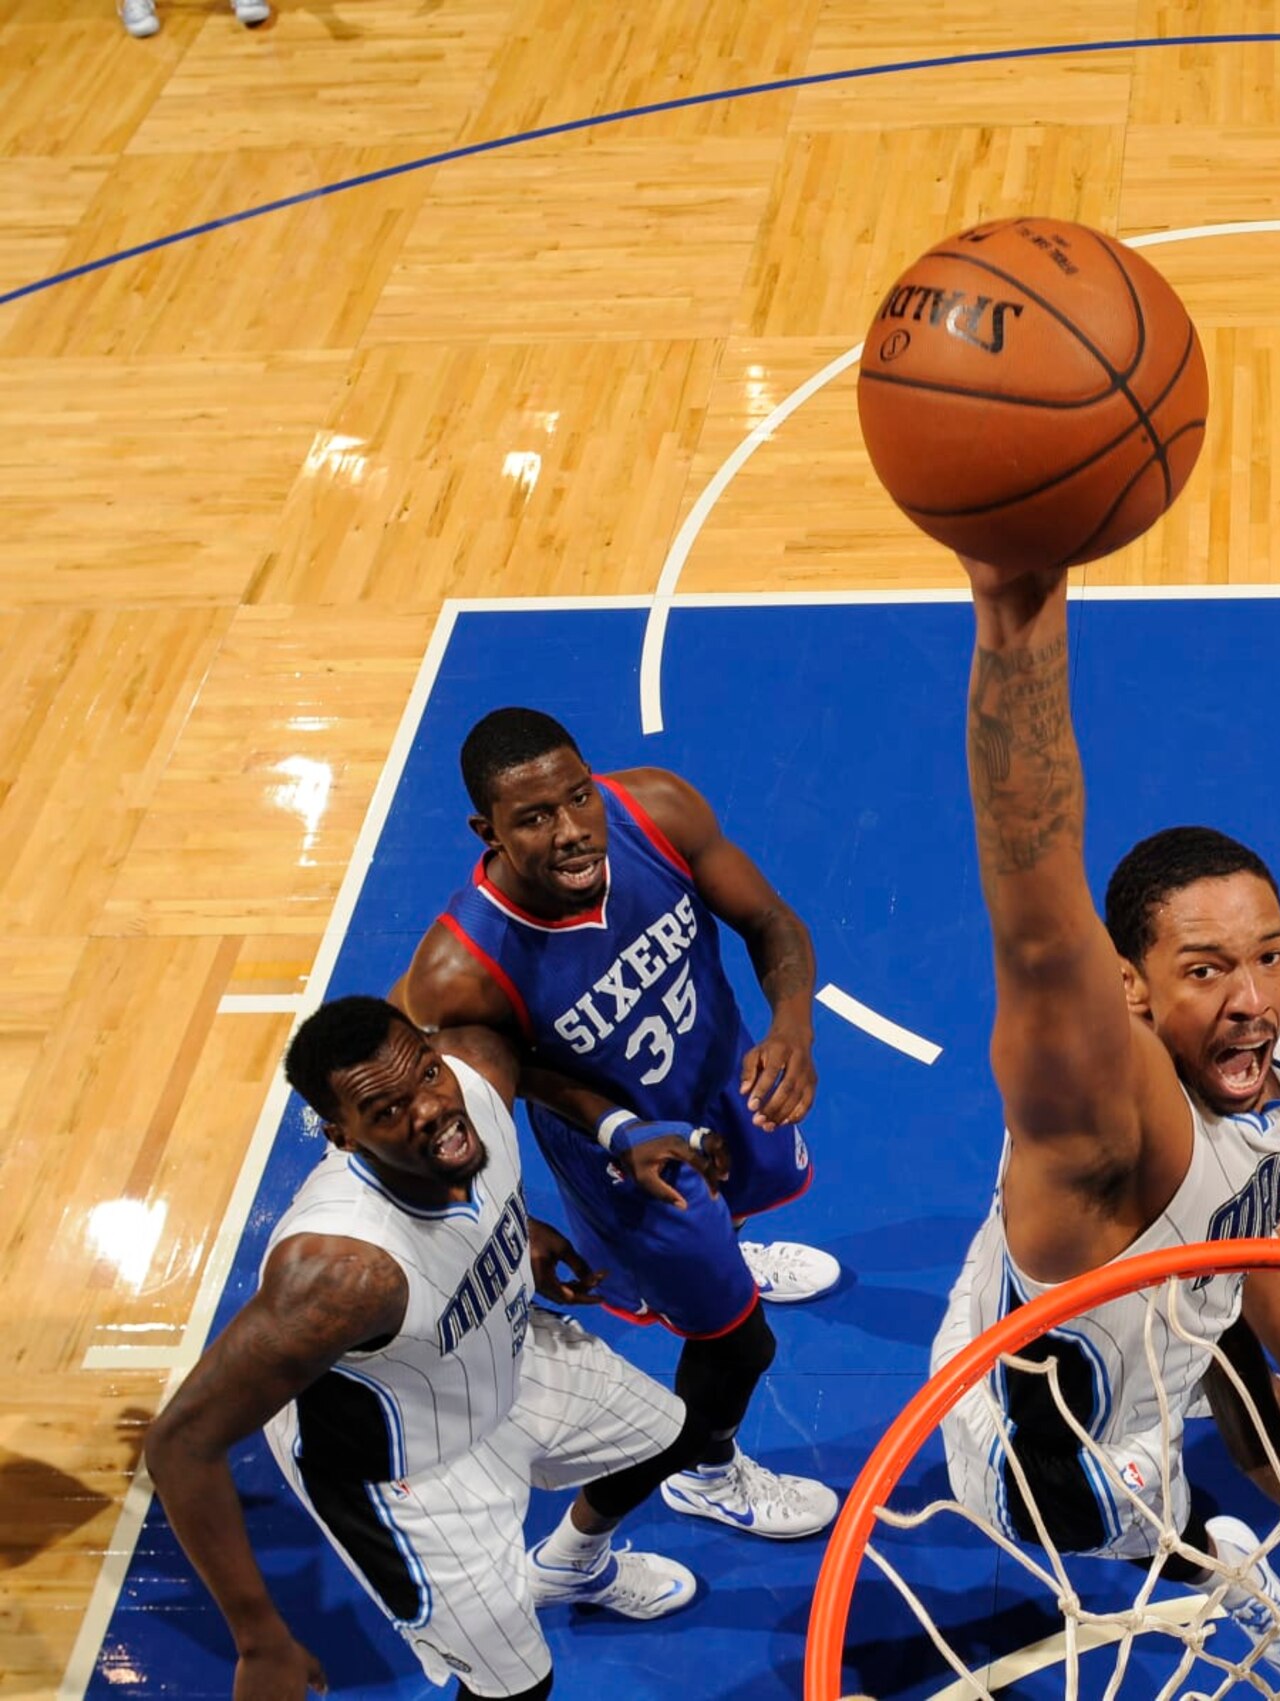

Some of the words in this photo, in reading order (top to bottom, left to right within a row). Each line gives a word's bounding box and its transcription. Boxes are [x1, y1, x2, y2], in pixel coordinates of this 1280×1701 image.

[554, 893, 698, 1054] SIXERS
[625, 957, 697, 1085] 35
[437, 1180, 528, 1357] MAGI
